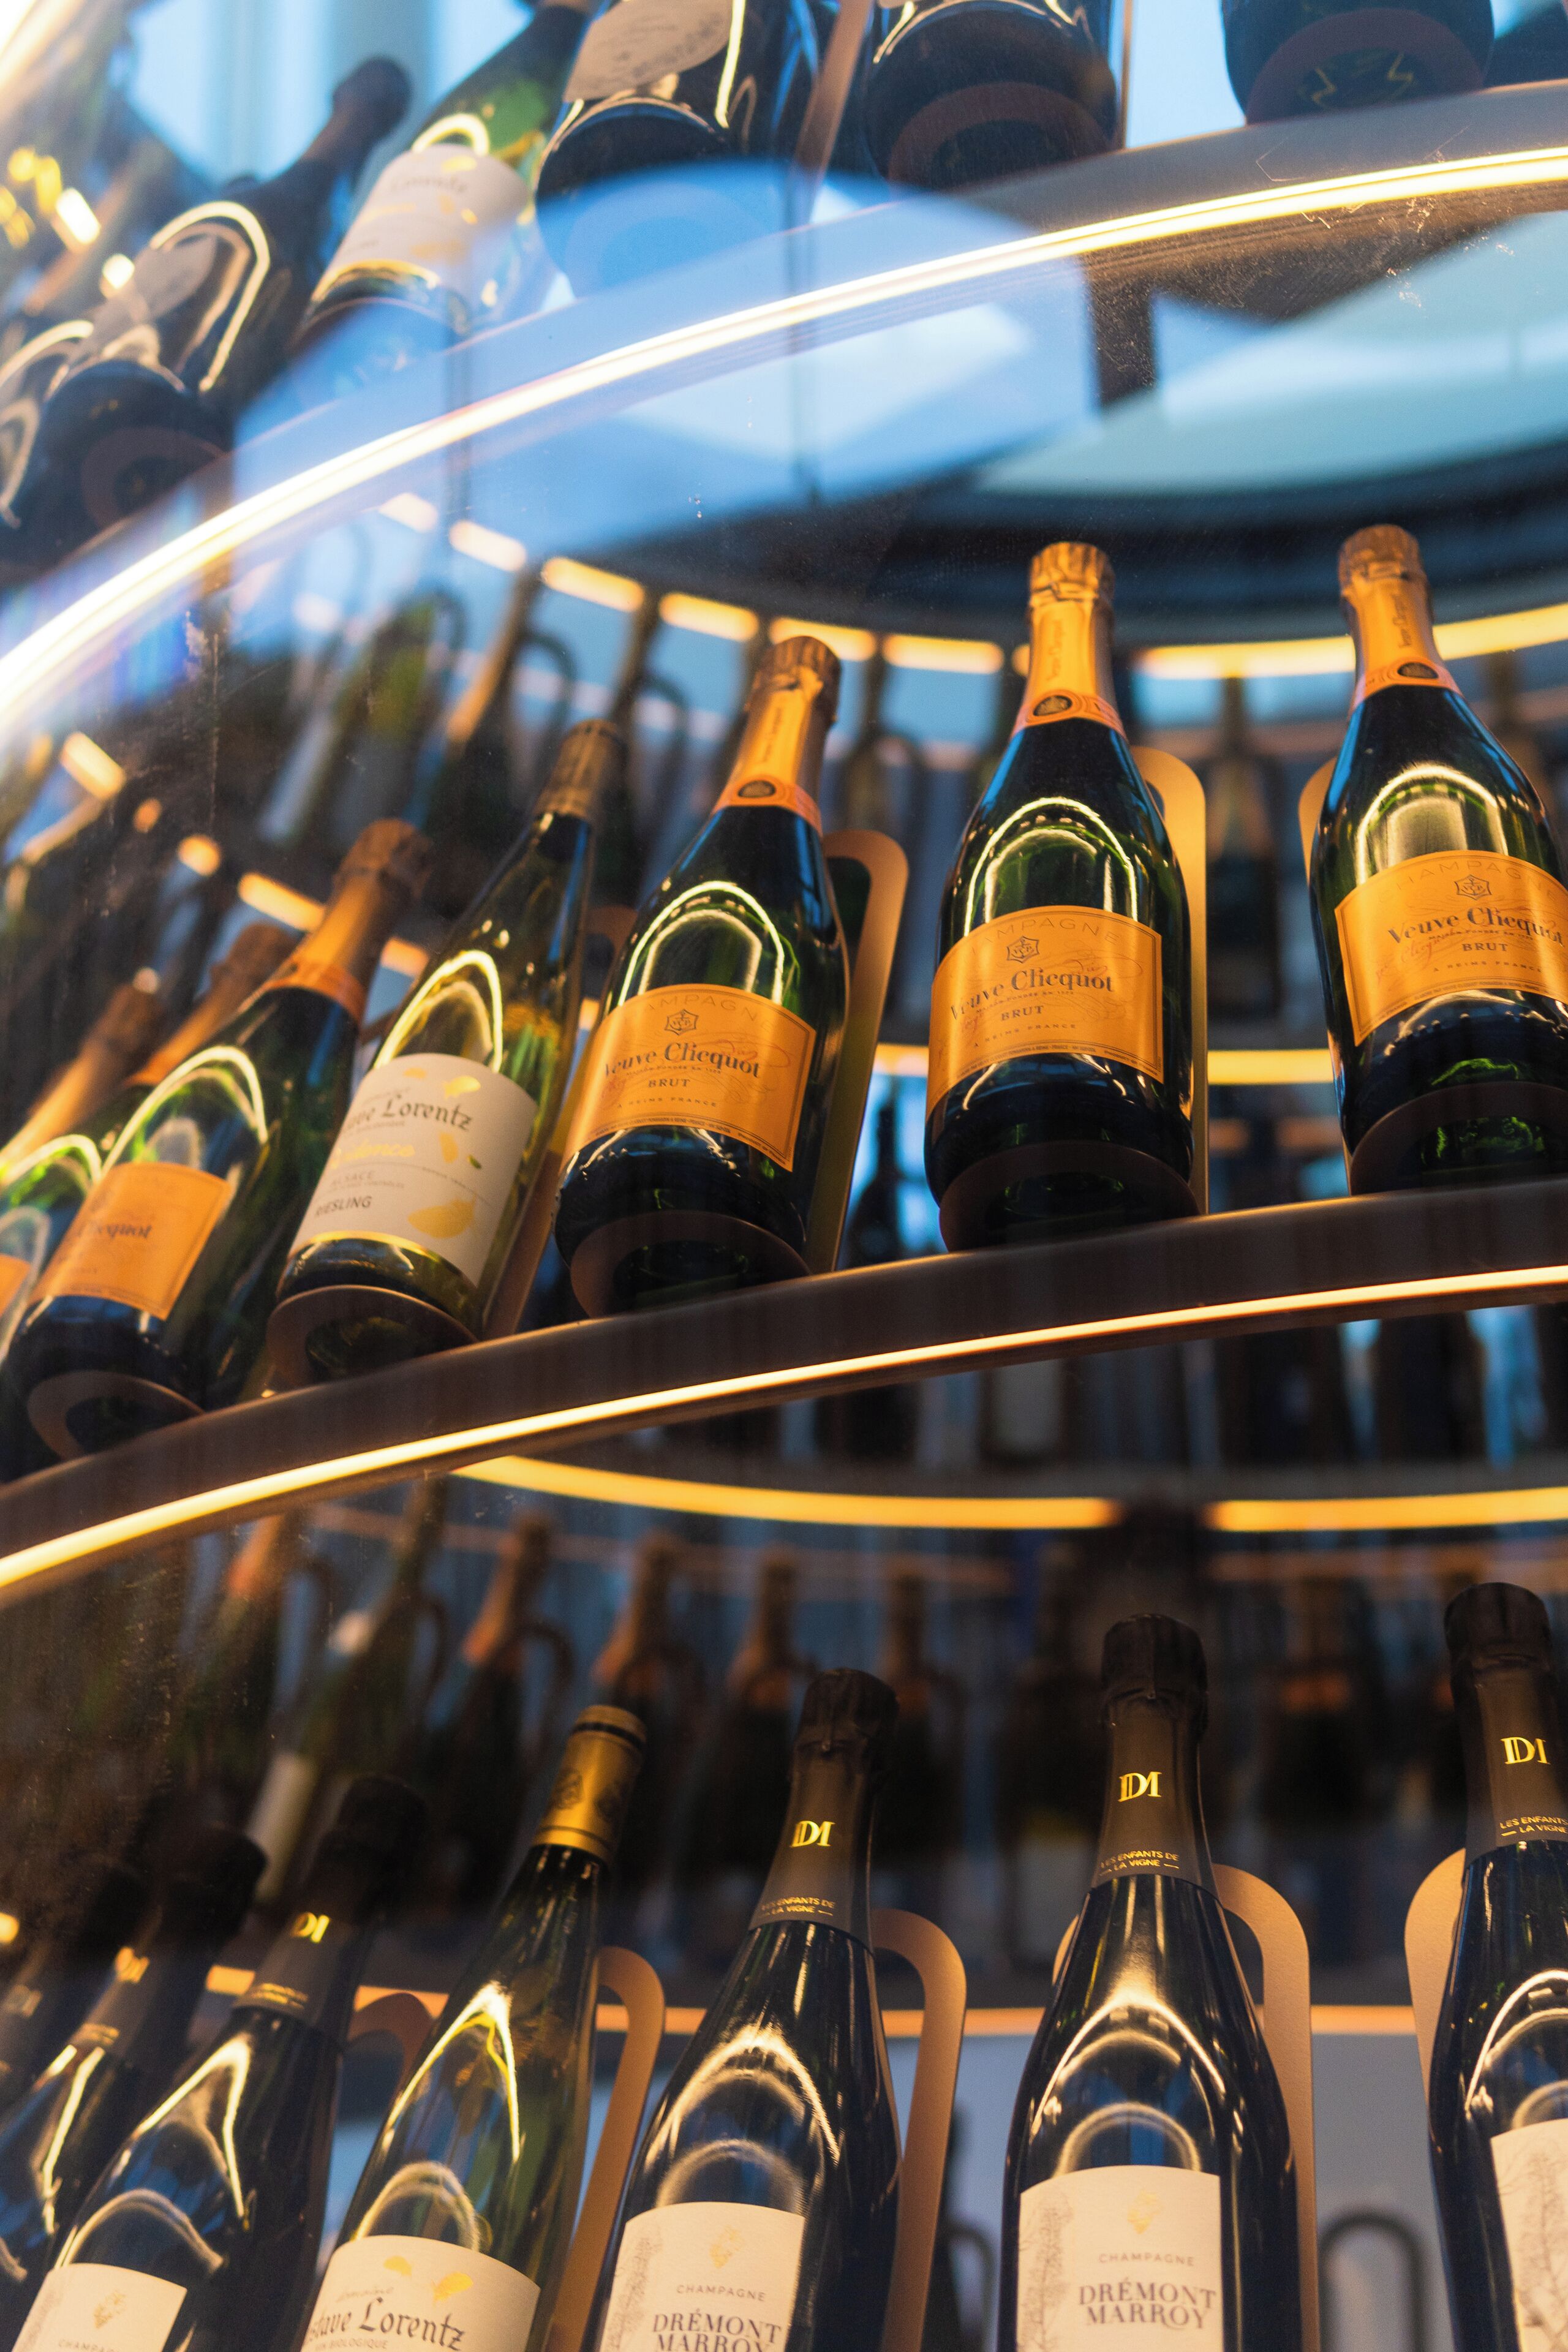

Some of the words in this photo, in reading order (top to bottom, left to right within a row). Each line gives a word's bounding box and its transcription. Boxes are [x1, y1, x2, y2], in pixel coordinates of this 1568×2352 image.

[1378, 859, 1559, 903] CHAMPAGE
[971, 918, 1120, 951] MPAGNE
[1387, 914, 1459, 944] Veuve
[1466, 907, 1565, 948] Clicquot
[1461, 942, 1509, 952] BRUT
[1011, 968, 1114, 993] Clicquot
[1001, 1005, 1044, 1022] BRUT
[664, 1042, 761, 1079] Clicquot
[647, 1078, 691, 1088] BRUT
[670, 1097, 717, 1107] FRANCE
[382, 1092, 473, 1133] Lorentz
[315, 1194, 373, 1217] RIESLING
[1499, 1817, 1520, 1830] LES
[1520, 1815, 1568, 1825] ENFANTS
[1519, 1825, 1536, 1833] LA
[1536, 1824, 1568, 1834] VIGNE
[1114, 1861, 1128, 1871] LA
[1128, 1858, 1161, 1867] VIGNE
[1117, 1850, 1164, 1862] ENFANTS
[1164, 1852, 1180, 1861] DE
[786, 1904, 816, 1913] VIGNE
[821, 1899, 836, 1909] DE
[1099, 2253, 1196, 2267] CHAMPAGNE
[676, 2285, 767, 2302] CHAMPAGNE
[1077, 2276, 1218, 2310] DRÉMONT
[309, 2309, 353, 2341] tave
[358, 2297, 467, 2351] Lorentz
[652, 2307, 782, 2344] DRÉMONT
[1084, 2304, 1206, 2331] MARROY
